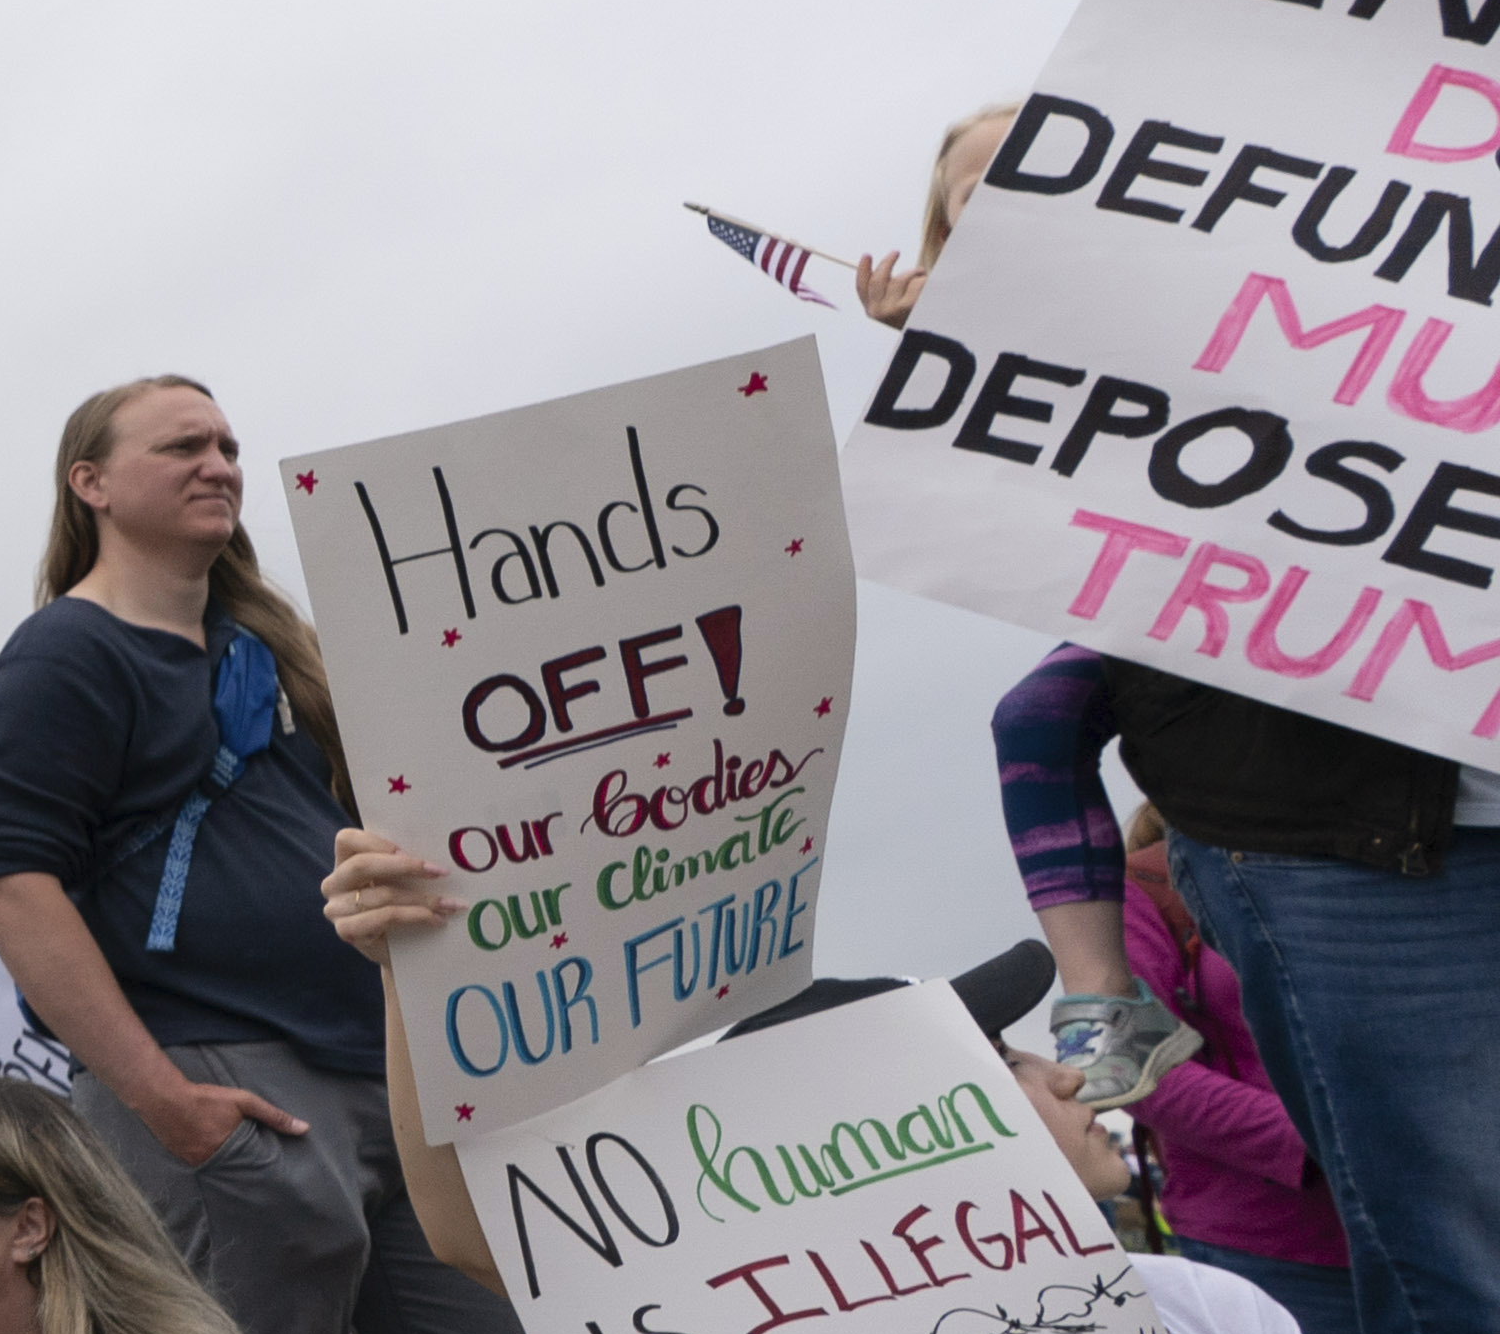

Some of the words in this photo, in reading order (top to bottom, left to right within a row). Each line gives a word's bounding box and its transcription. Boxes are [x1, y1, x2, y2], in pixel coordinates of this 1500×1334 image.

[983, 91, 1500, 307] DEFUN
[354, 426, 719, 634] Hands
[864, 328, 1500, 590] DEPOSE
[462, 605, 743, 754] OFF!
[580, 739, 825, 838] bodies
[445, 955, 599, 1078] OUR
[624, 856, 820, 1029] FUTURE
[505, 1131, 680, 1299] NO
[687, 1081, 1018, 1224] human
